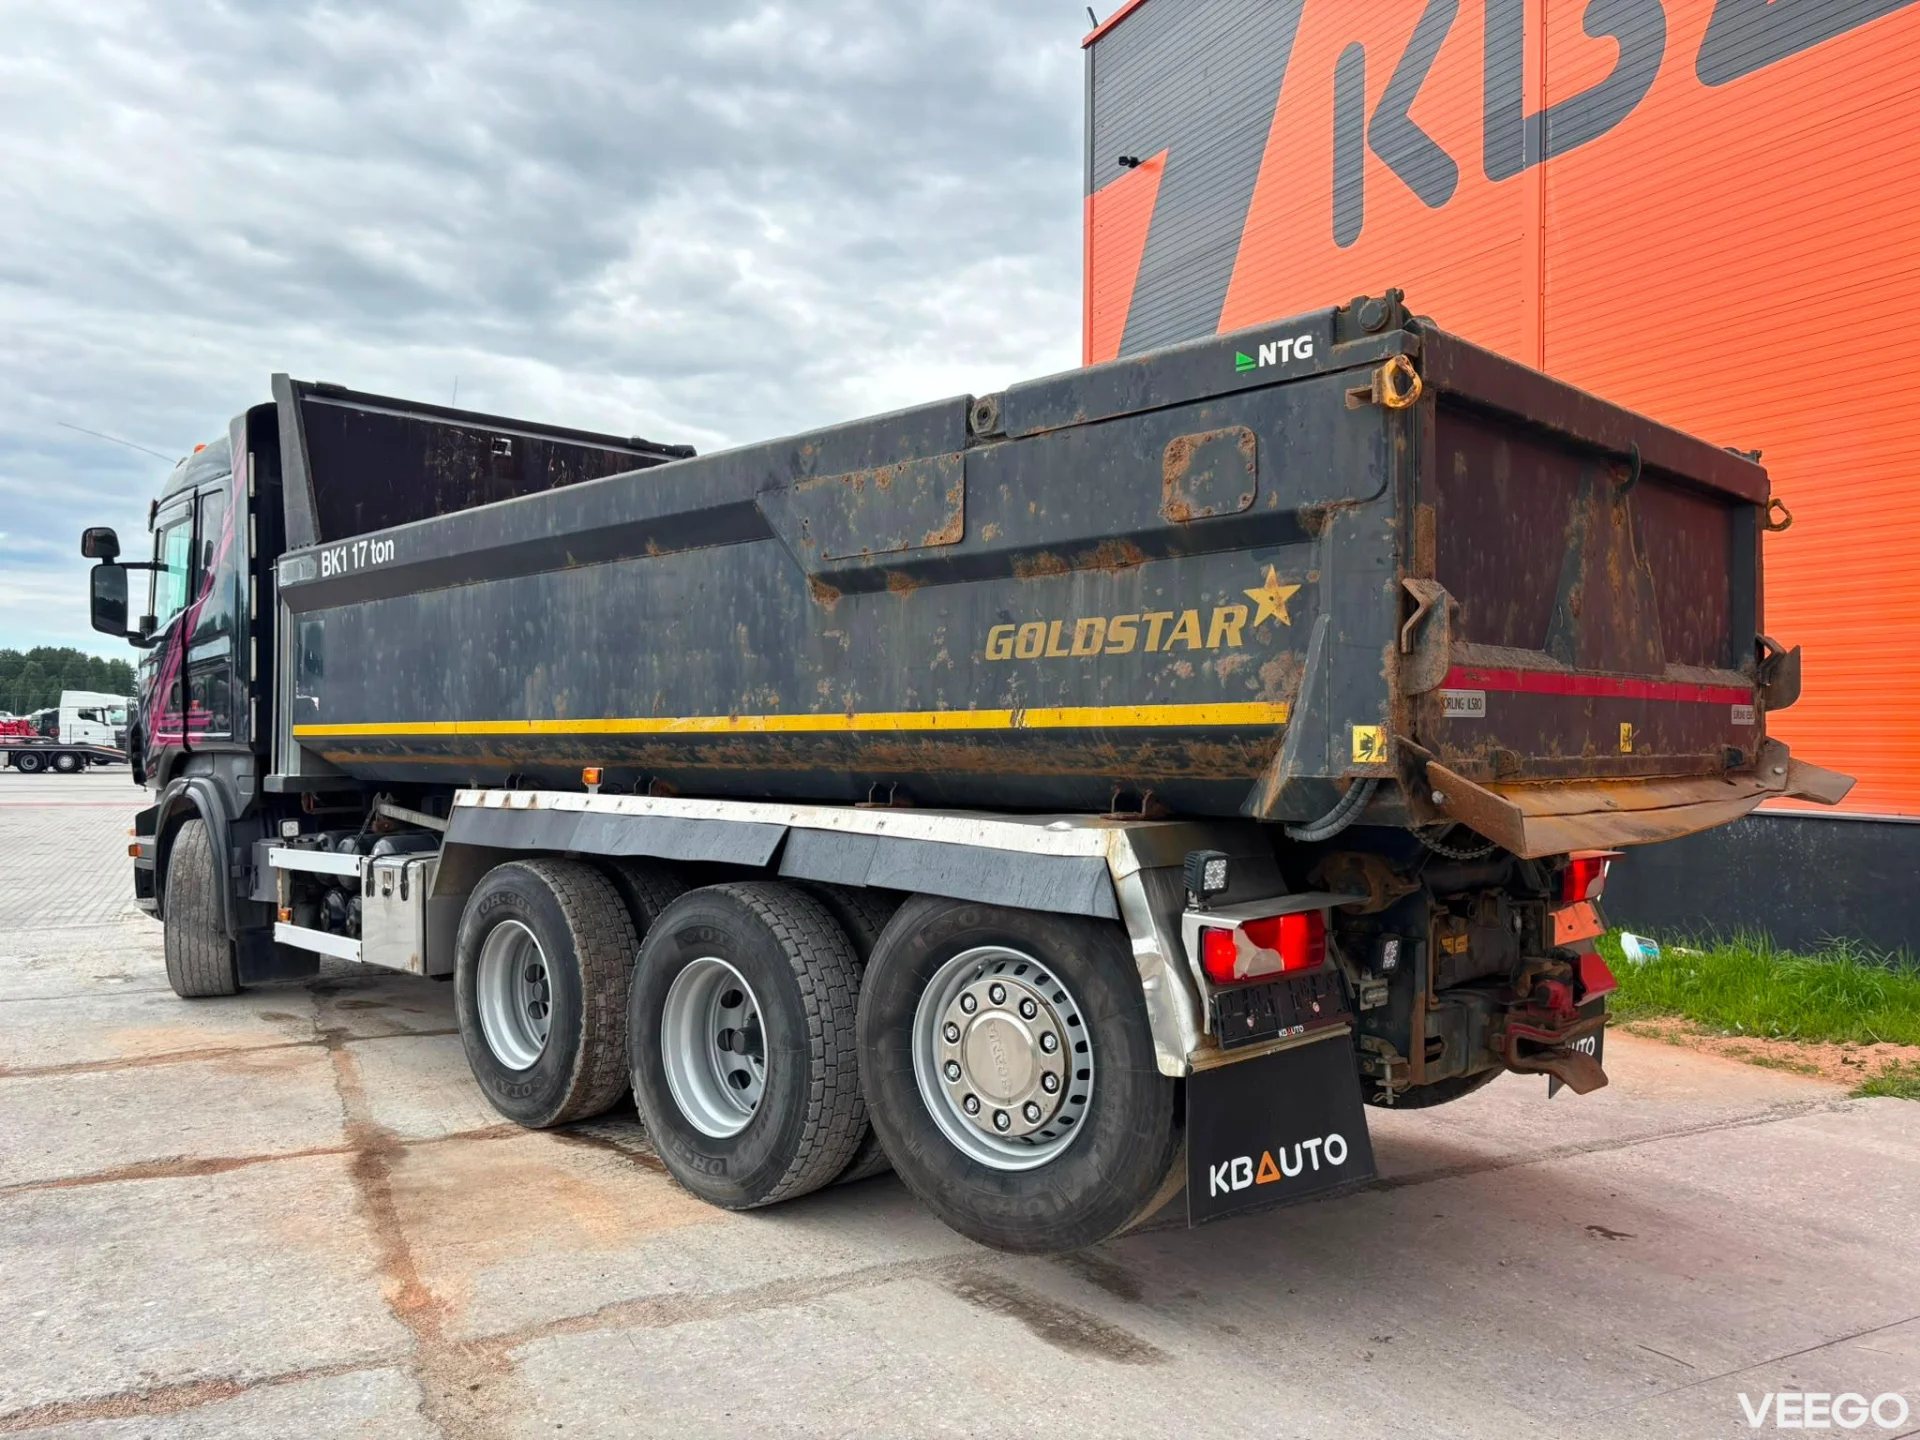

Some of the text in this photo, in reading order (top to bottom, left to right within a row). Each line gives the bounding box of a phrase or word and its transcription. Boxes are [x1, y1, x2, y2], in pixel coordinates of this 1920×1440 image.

[1258, 335, 1313, 368] NTG
[321, 539, 395, 577] BK1 17 ton
[985, 604, 1248, 660] GOLDSTAR
[1278, 1024, 1304, 1037] KBAUTO
[1209, 1133, 1348, 1197] KBAUTO
